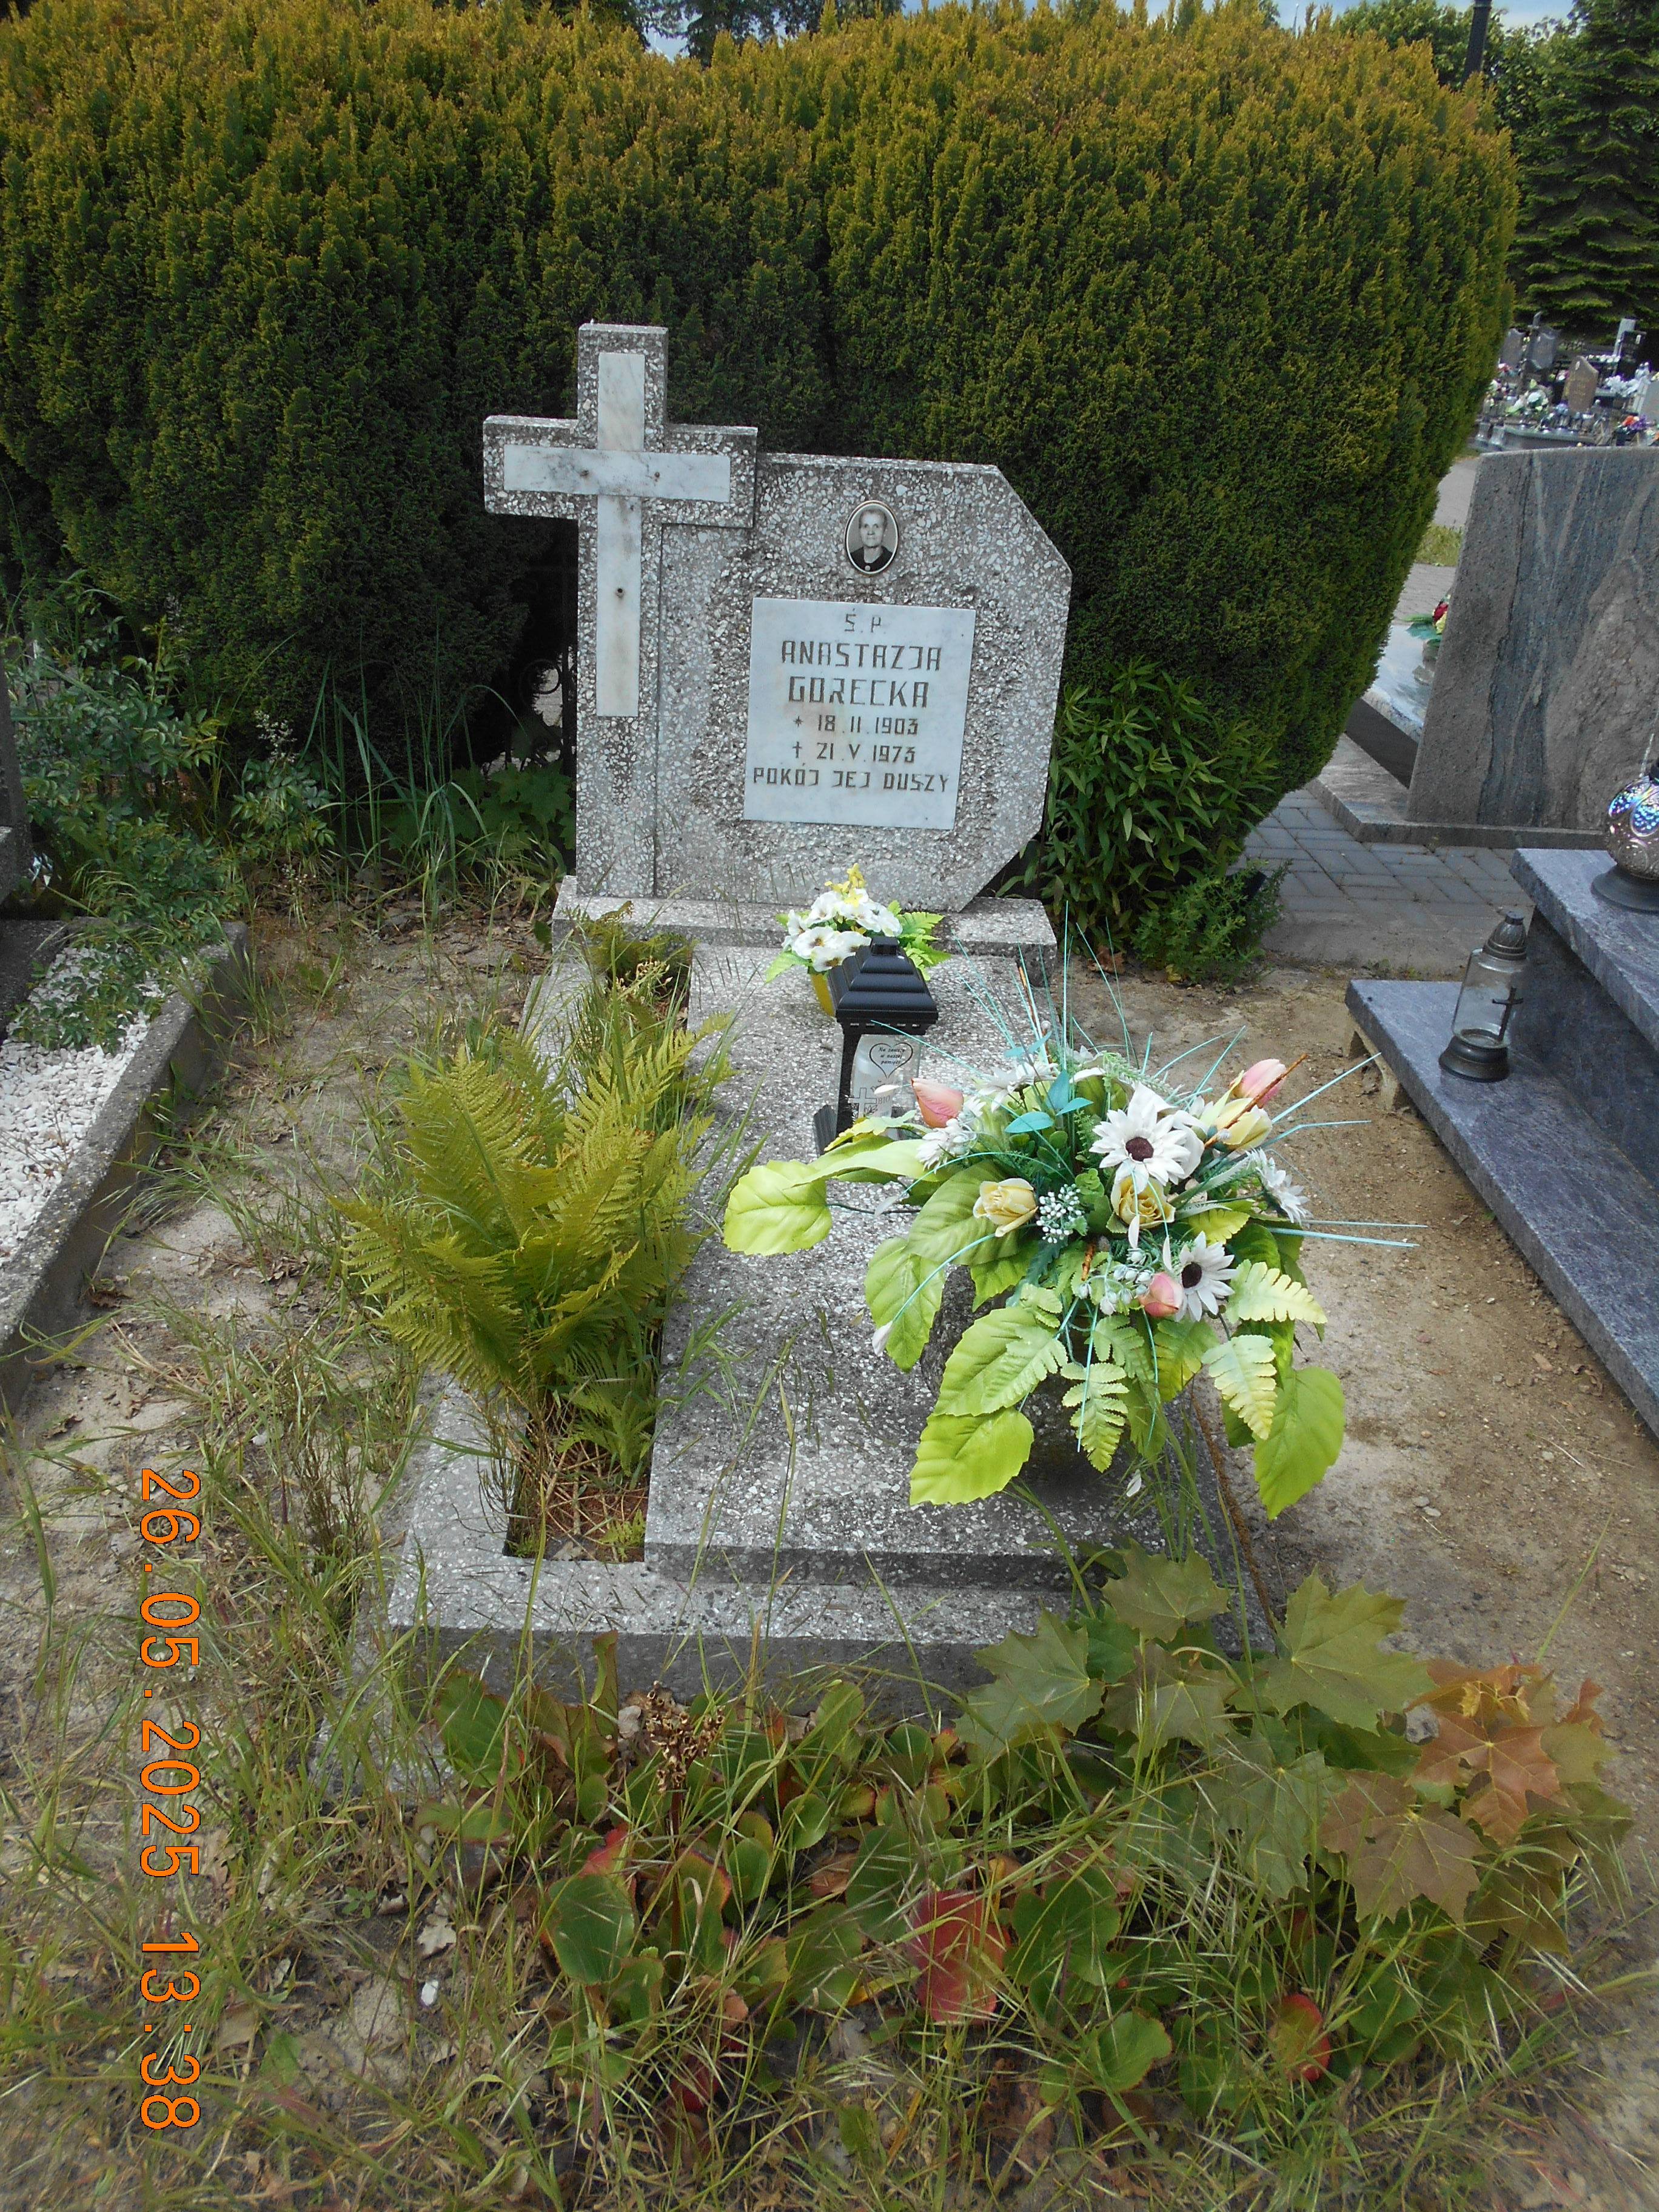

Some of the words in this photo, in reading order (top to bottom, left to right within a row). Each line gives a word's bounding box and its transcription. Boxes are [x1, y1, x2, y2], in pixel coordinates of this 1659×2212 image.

[781, 640, 942, 671] ANASTAZJA
[753, 762, 820, 787] POKÓJ
[831, 770, 871, 789] JEJ
[883, 773, 949, 793] DUSZY
